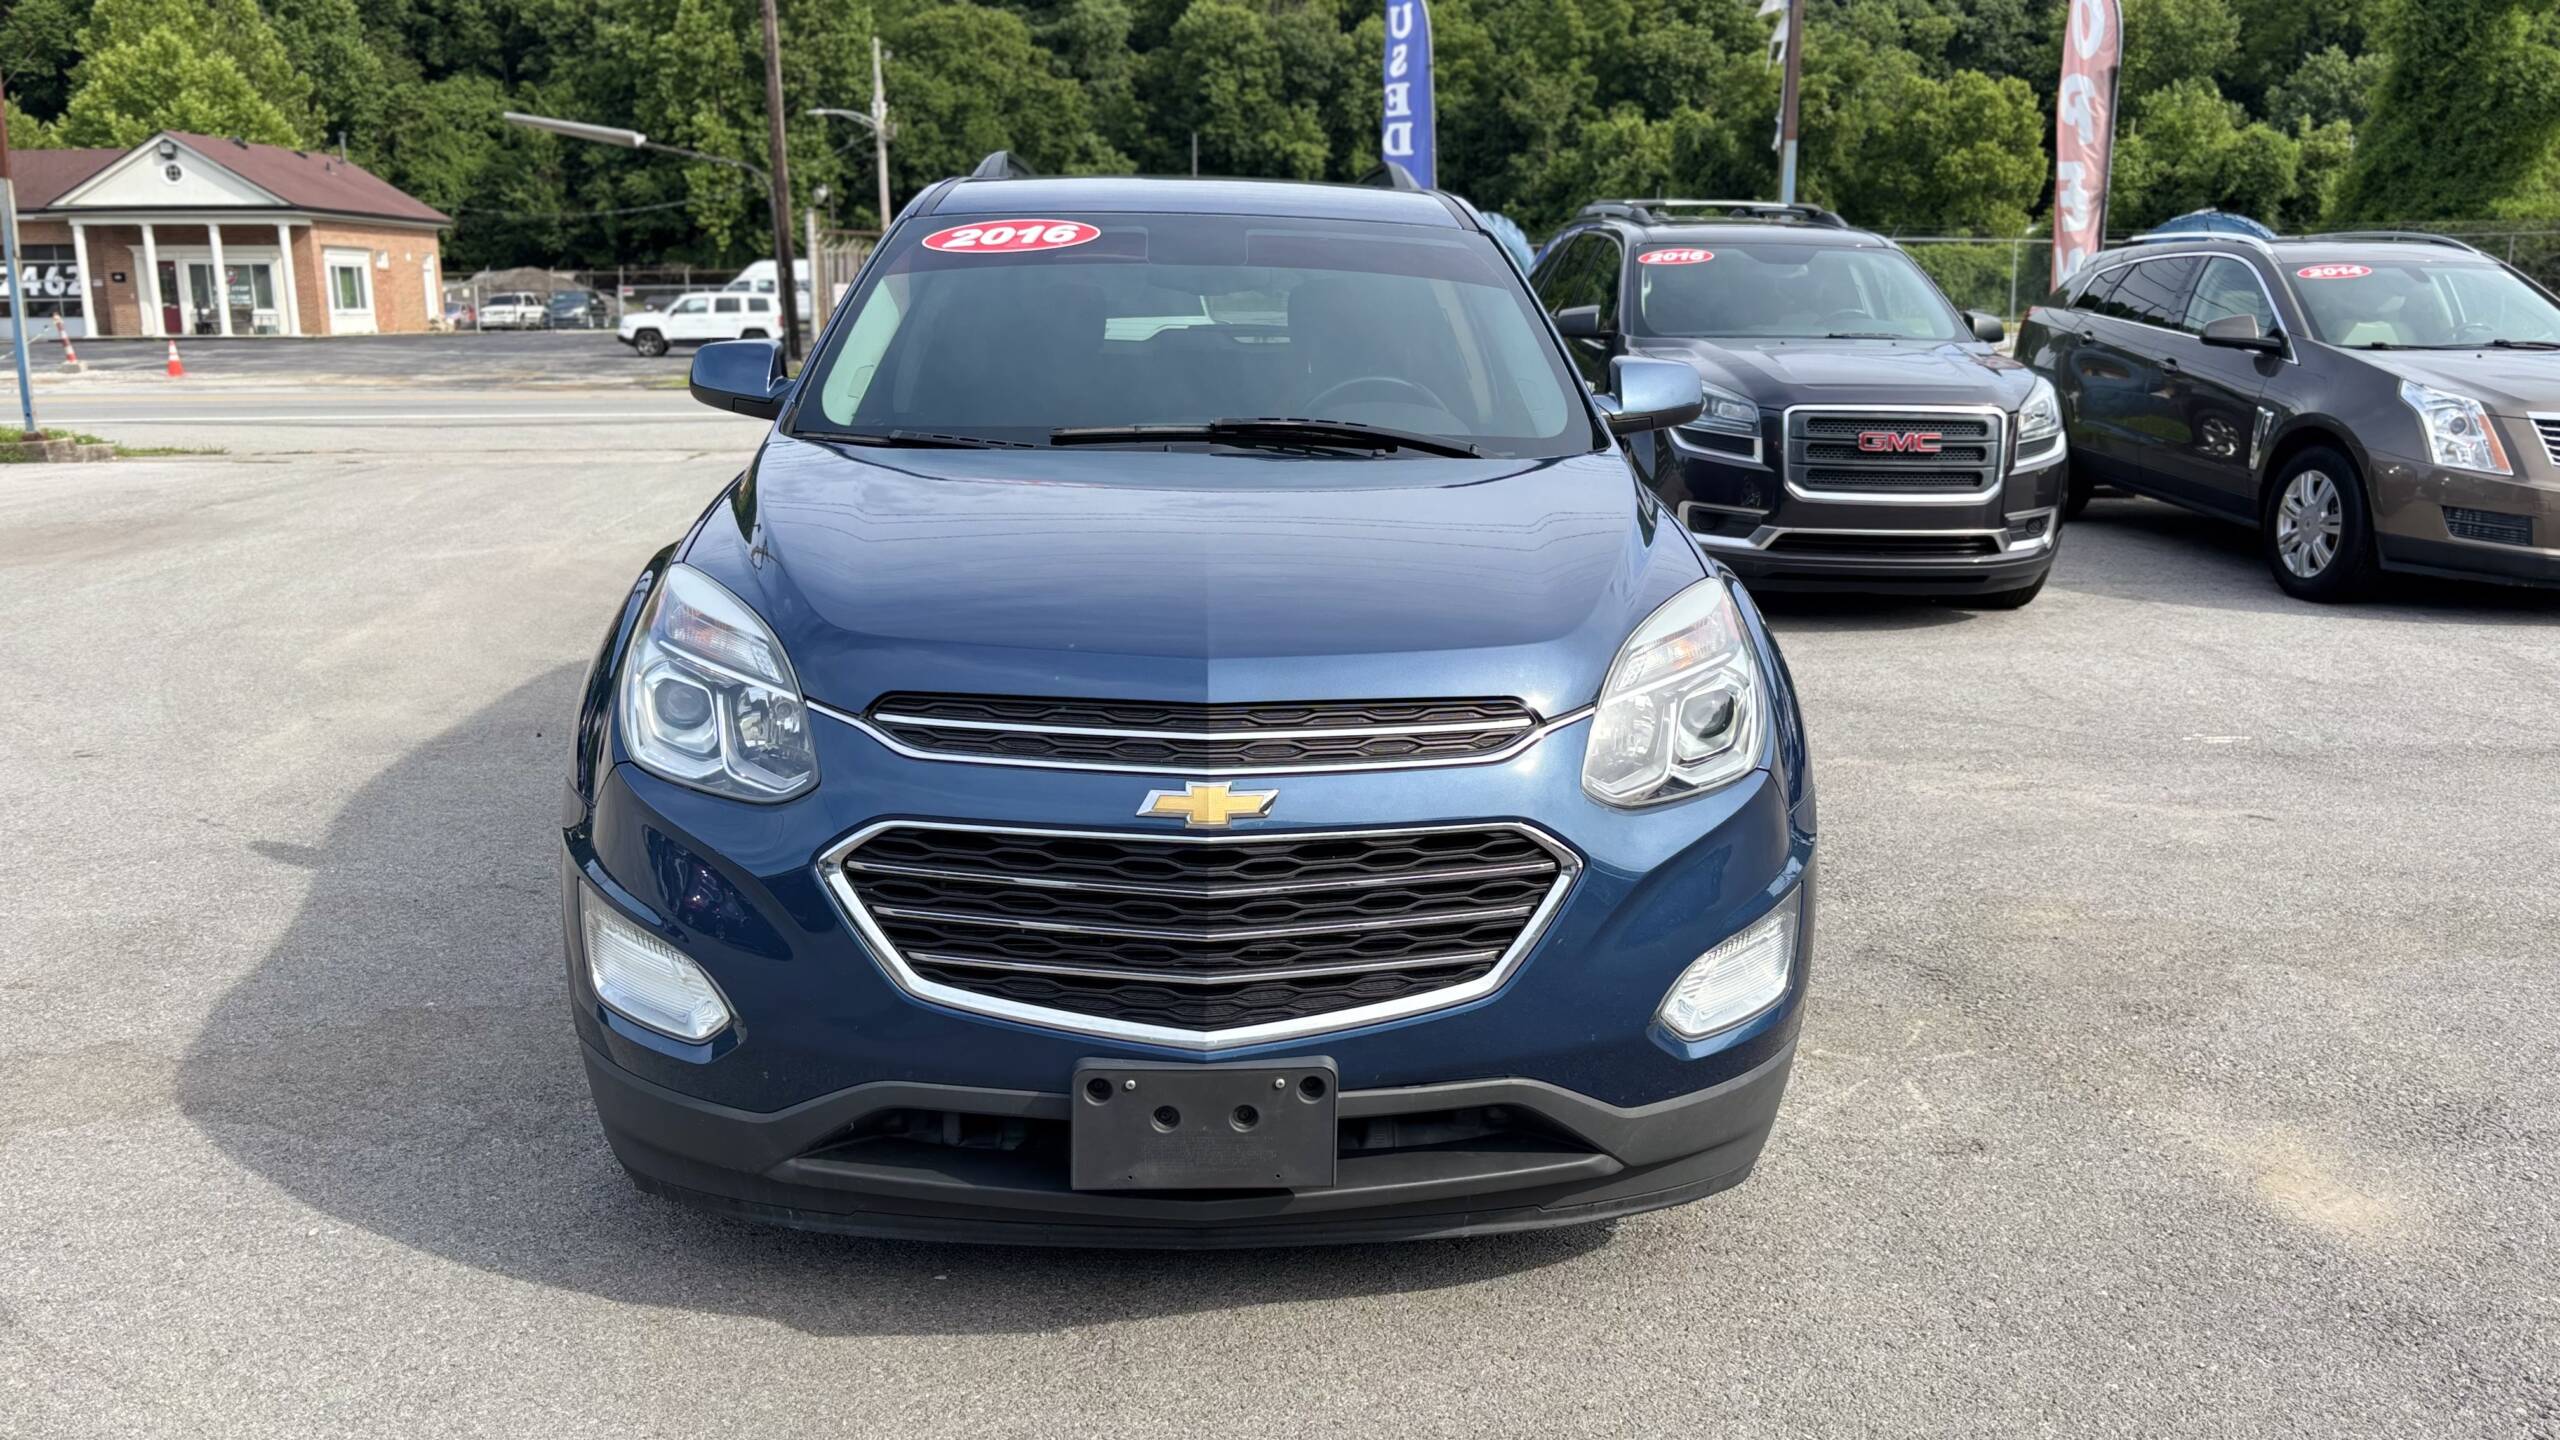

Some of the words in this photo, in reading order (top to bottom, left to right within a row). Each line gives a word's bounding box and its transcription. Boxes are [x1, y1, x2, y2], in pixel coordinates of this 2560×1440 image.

[941, 224, 1081, 249] 2016
[1647, 251, 1705, 264] 2016
[2308, 265, 2362, 279] 2014
[1858, 431, 1943, 452] GMC
